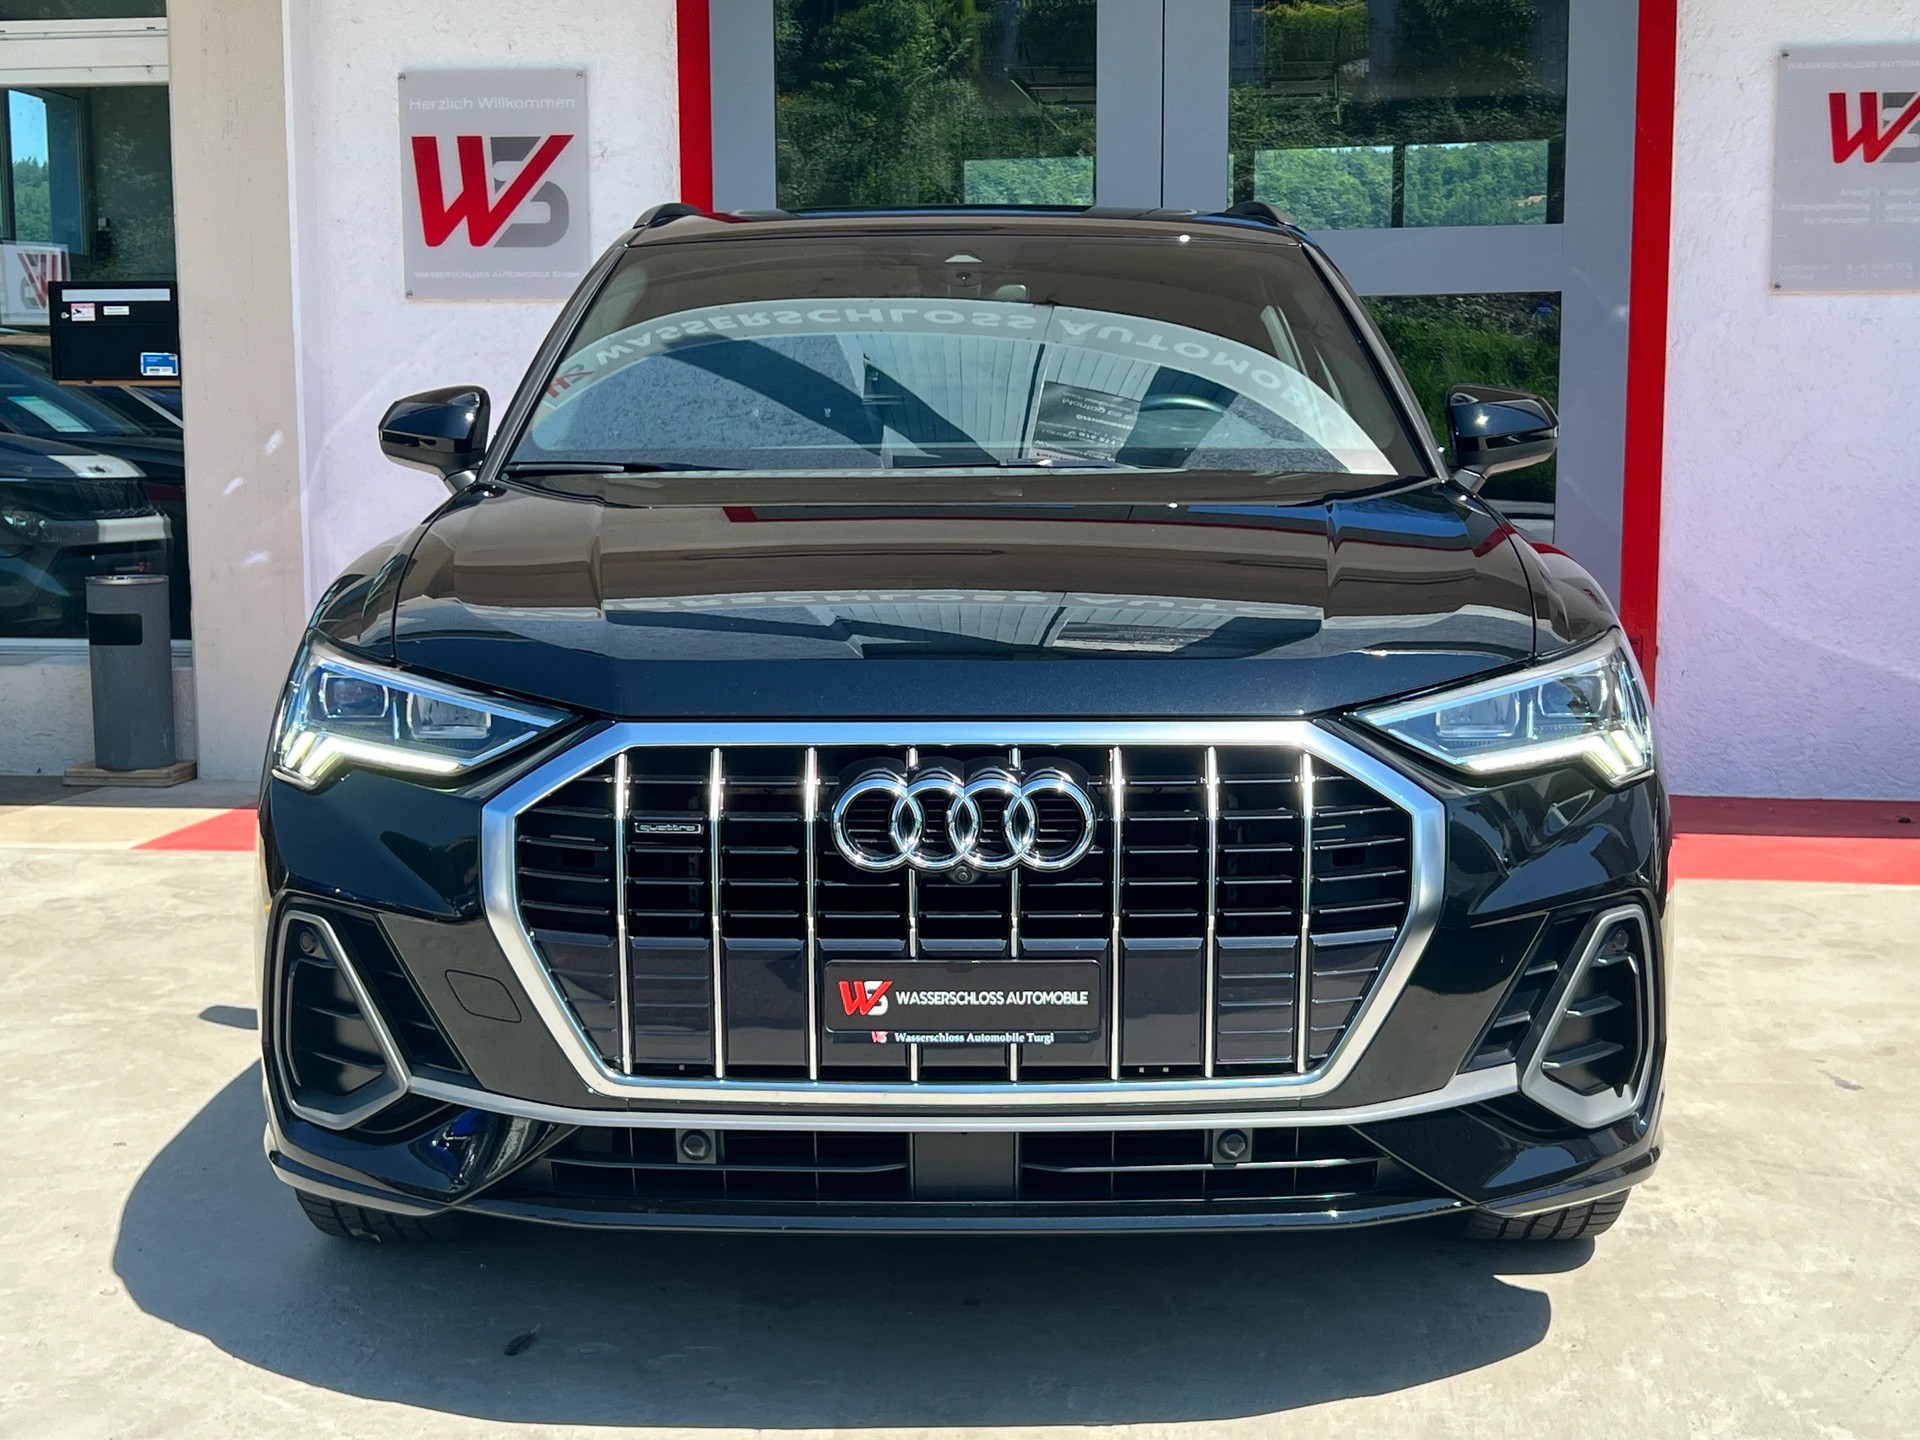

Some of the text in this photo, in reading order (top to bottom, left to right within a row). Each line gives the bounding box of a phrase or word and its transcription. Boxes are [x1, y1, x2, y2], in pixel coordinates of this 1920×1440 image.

[409, 95, 576, 111] Herzlich Willkommen
[640, 824, 696, 832] quattro
[896, 991, 1004, 1006] WASSERSCHLOSS
[1007, 990, 1089, 1006] AUTOMOBILE
[895, 1032, 962, 1043] Wasserschloss
[966, 1032, 1025, 1043] Automobile
[1027, 1032, 1054, 1044] Turgi
